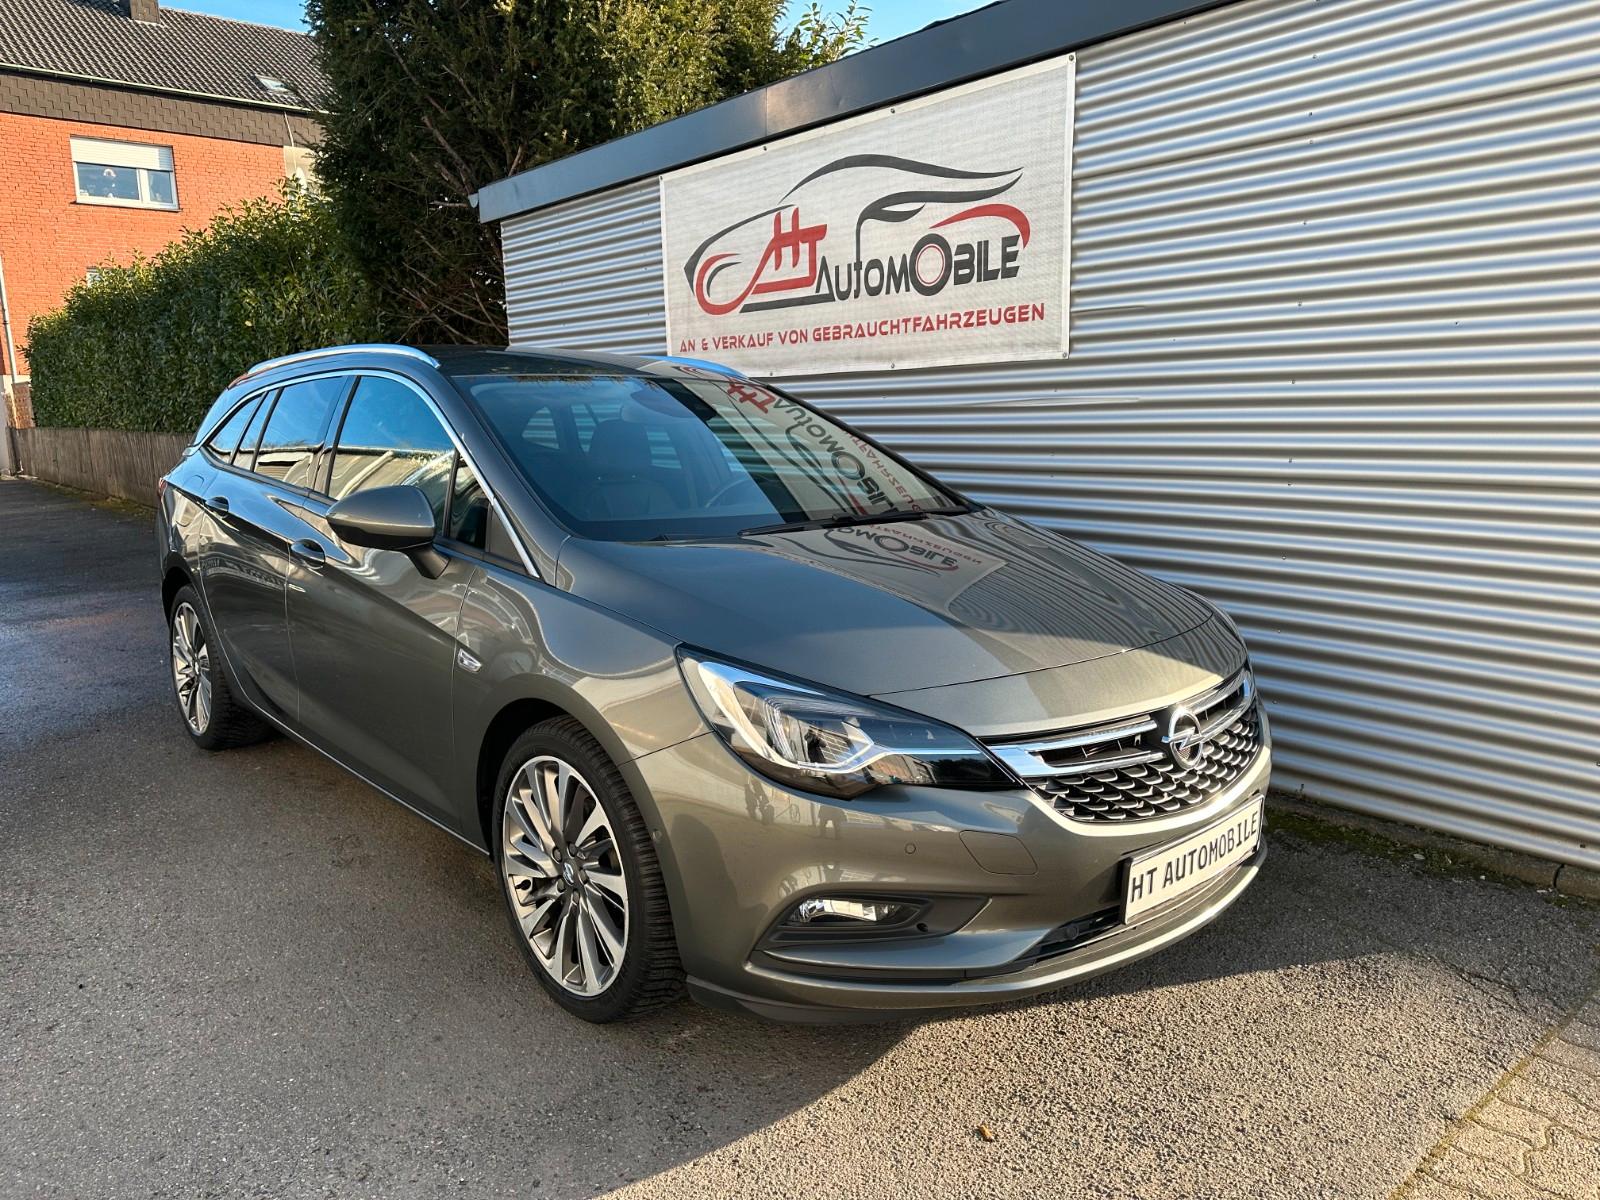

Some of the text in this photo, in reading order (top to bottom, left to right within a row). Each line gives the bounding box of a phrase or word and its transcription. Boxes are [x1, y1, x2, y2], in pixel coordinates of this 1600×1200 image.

[751, 207, 828, 296] HT
[680, 302, 1045, 352] AN & VERKAUF VON GEBRAUCHTFAHRZEUGEN
[1130, 810, 1258, 903] HT AUTOMOBILE
